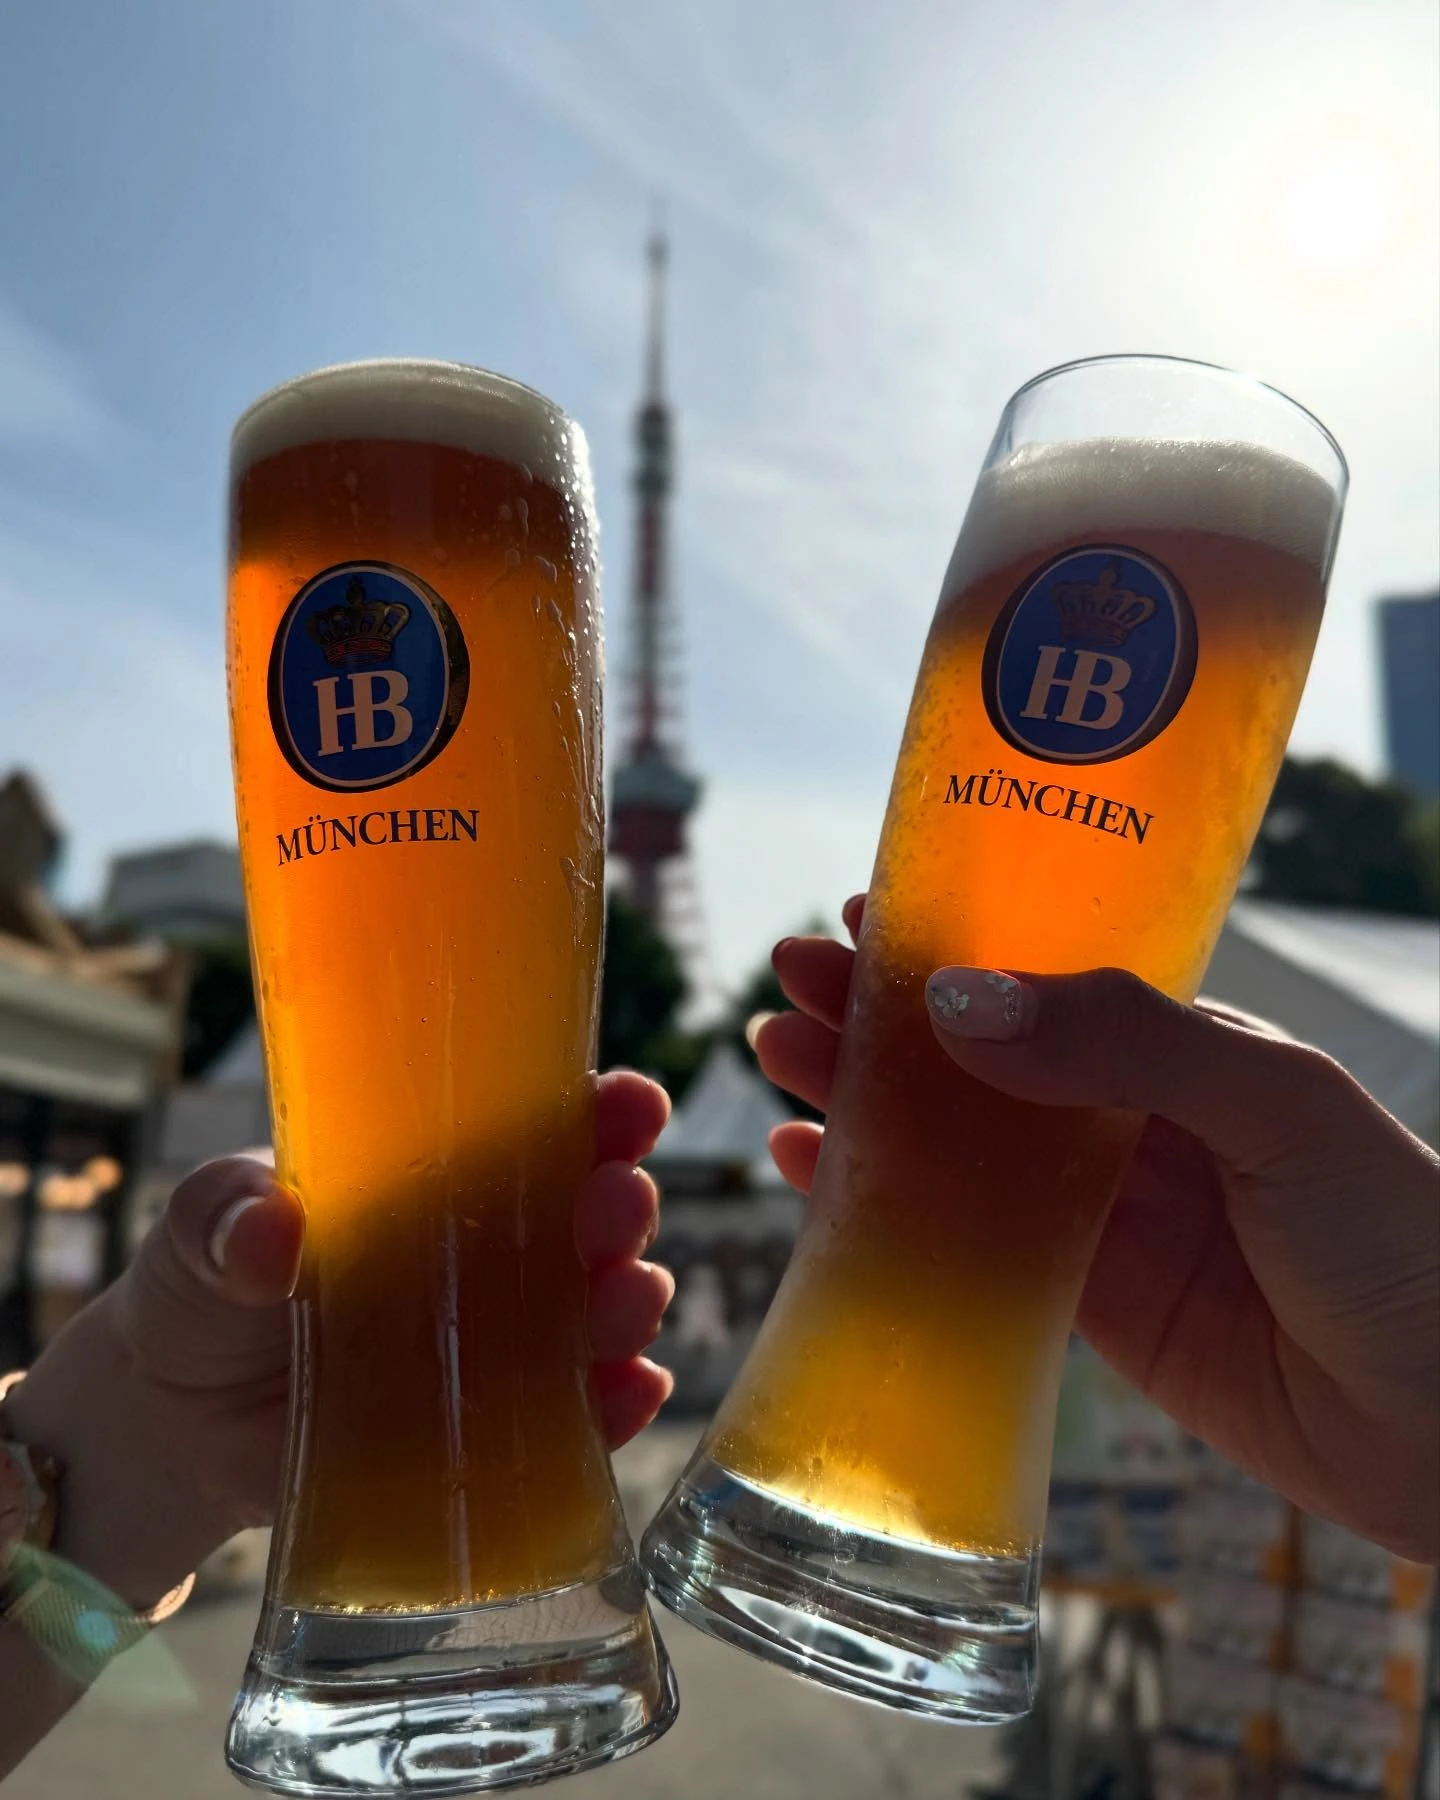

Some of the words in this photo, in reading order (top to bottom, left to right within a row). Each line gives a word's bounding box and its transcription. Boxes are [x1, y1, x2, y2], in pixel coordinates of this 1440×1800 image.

[312, 669, 414, 757] HB
[1020, 645, 1132, 730] HB
[276, 808, 480, 866] MÜNCHEN
[944, 768, 1154, 844] MÜNCHEN
